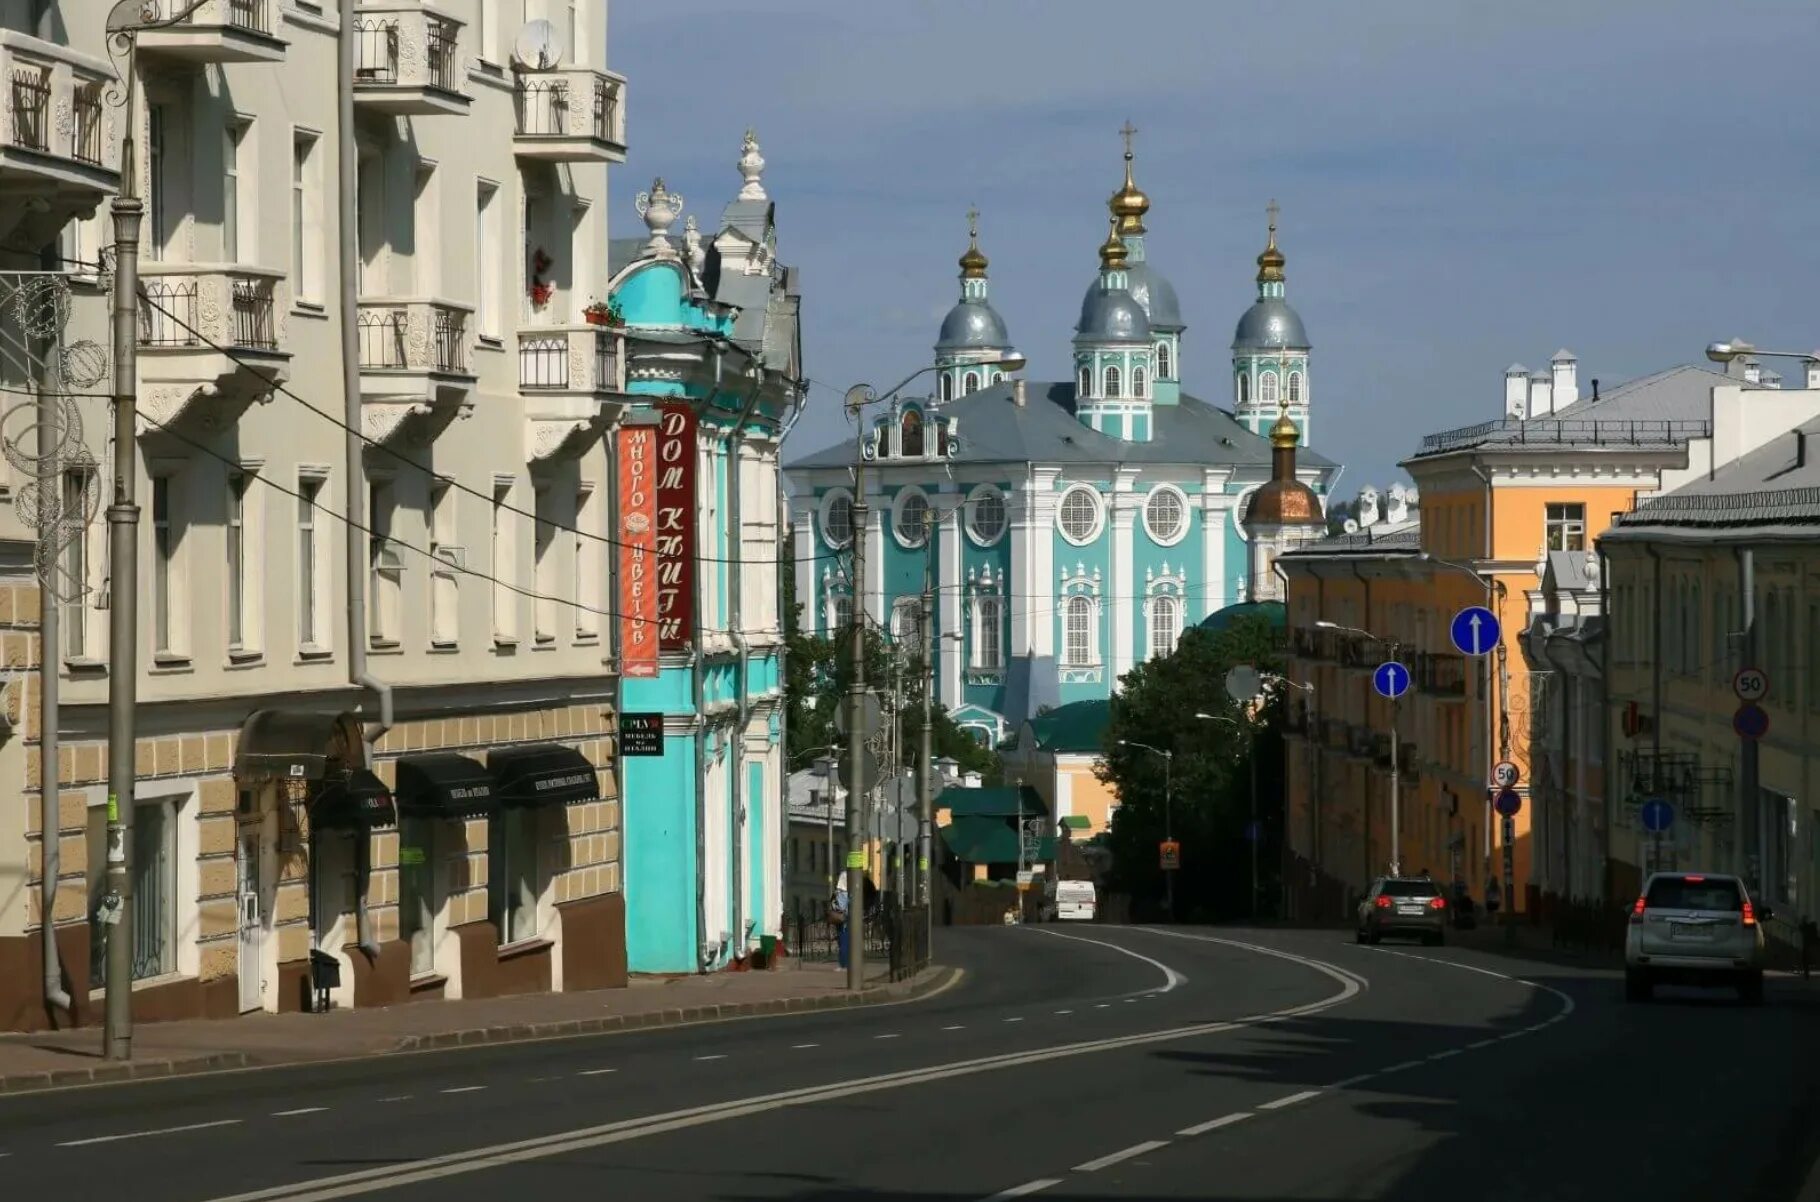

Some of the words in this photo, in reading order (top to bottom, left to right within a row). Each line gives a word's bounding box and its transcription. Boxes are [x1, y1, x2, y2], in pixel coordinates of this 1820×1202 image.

[627, 430, 648, 507] МНОГО
[656, 412, 686, 490] ДОМ
[631, 542, 646, 646] ЦВЕТОВ
[656, 507, 685, 641] КНИГИ
[1740, 676, 1760, 692] 50
[1498, 767, 1514, 780] 50
